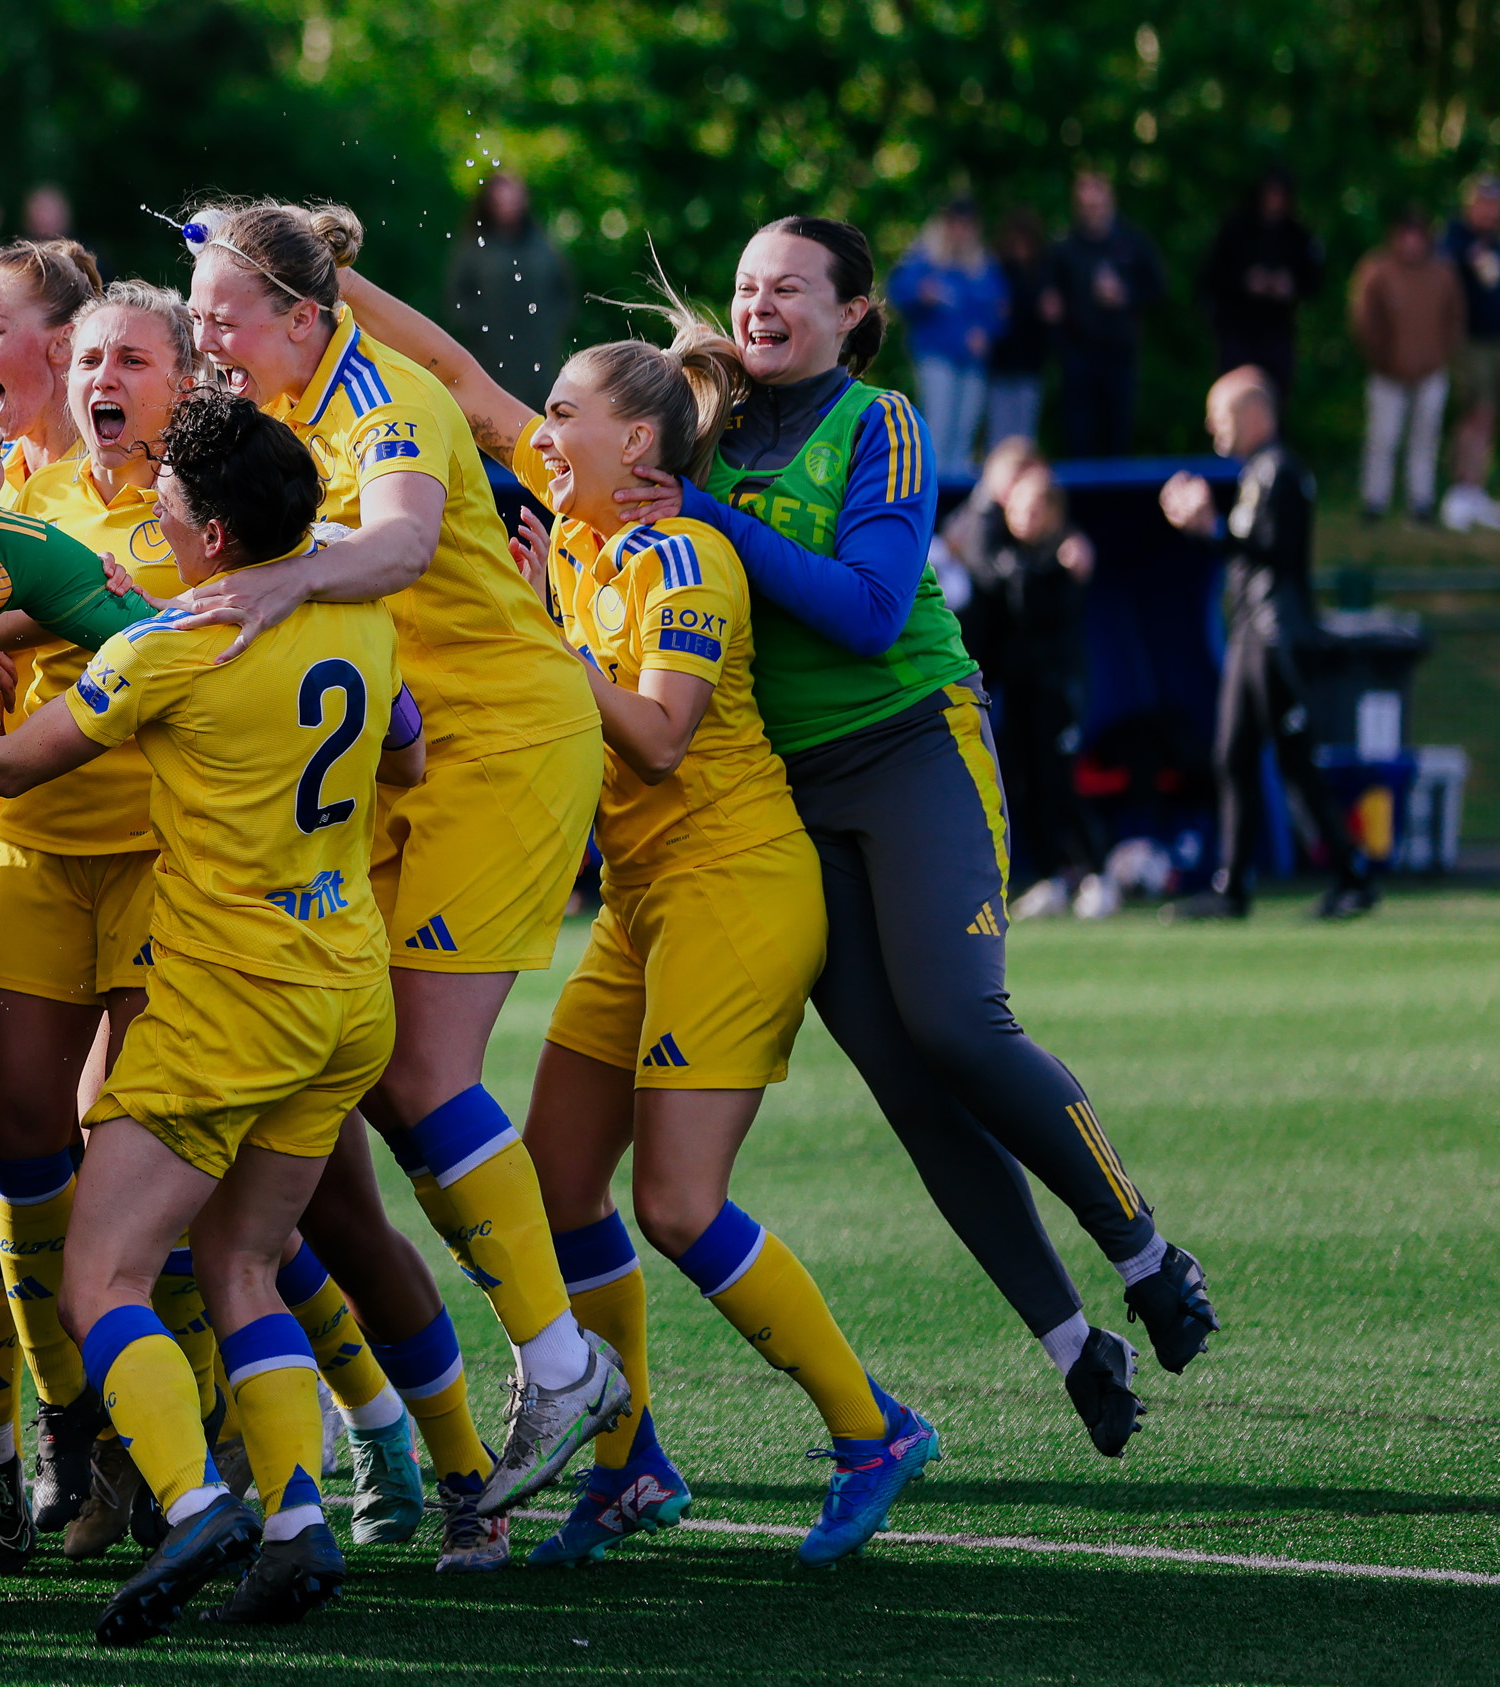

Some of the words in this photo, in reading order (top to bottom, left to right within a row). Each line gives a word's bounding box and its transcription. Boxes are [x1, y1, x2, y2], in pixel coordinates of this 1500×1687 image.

[661, 607, 728, 637] BOXT
[671, 631, 715, 658] LIFE
[90, 653, 132, 694] OXT
[295, 657, 368, 835] 2
